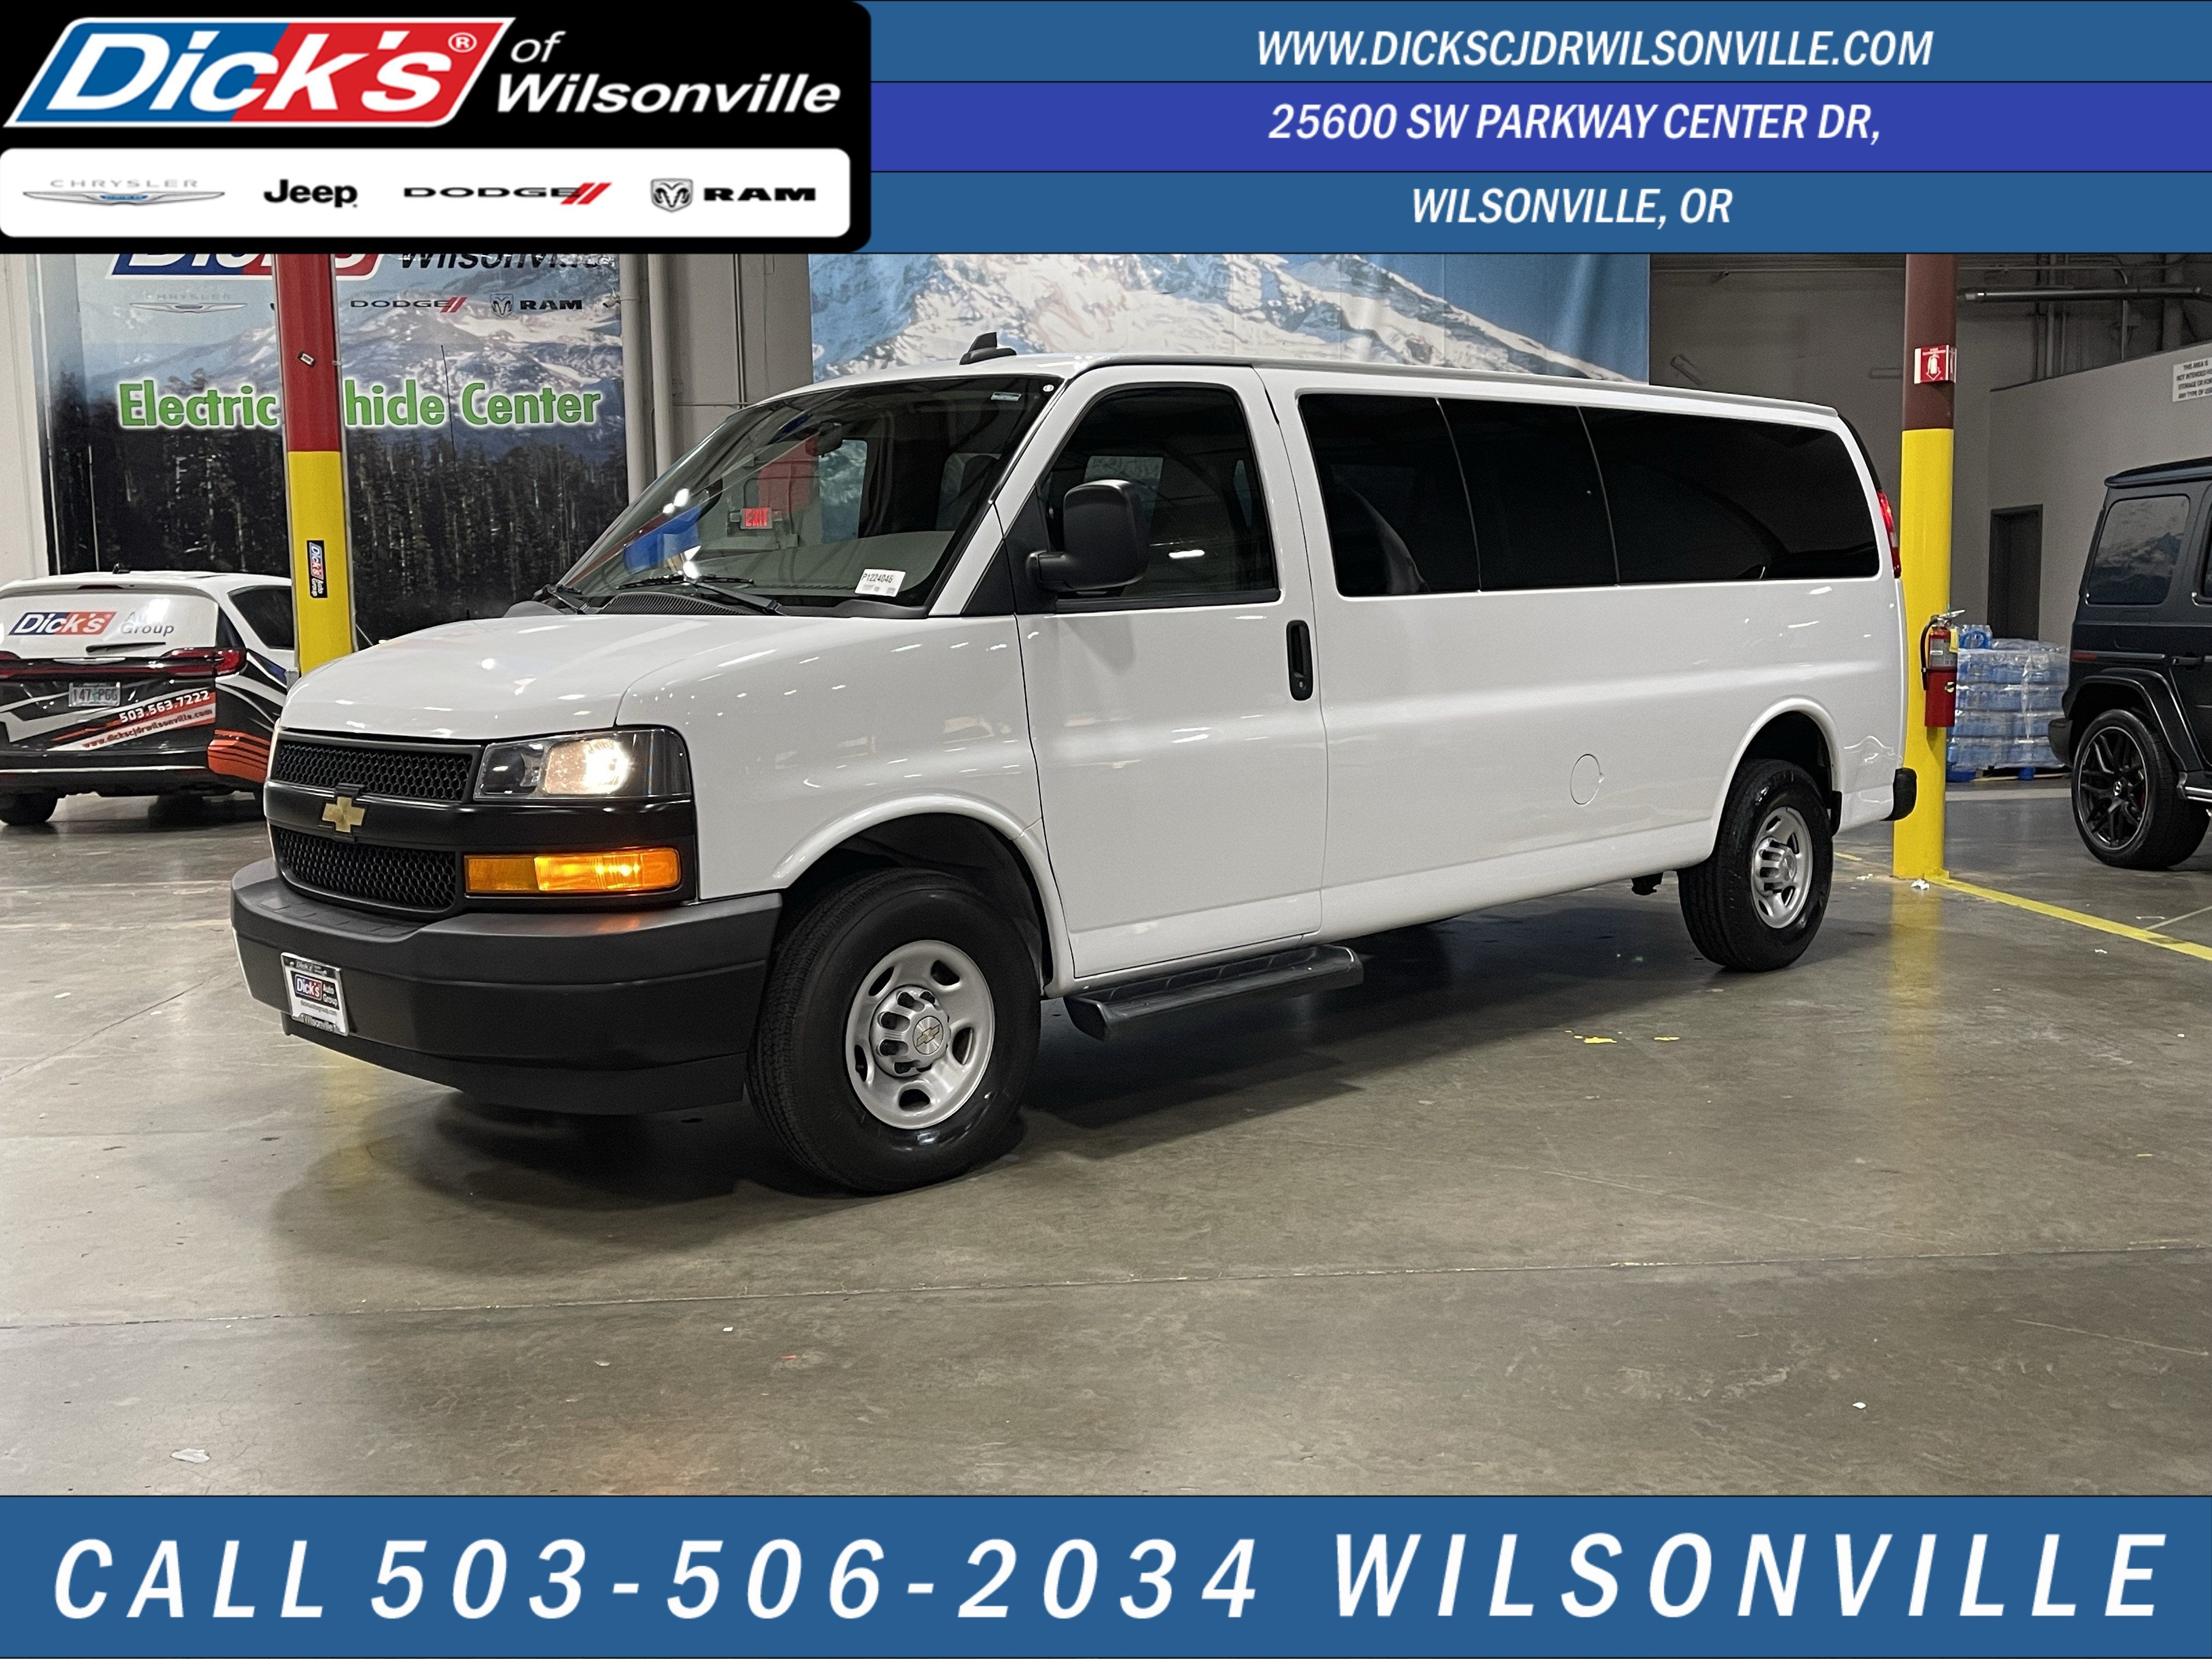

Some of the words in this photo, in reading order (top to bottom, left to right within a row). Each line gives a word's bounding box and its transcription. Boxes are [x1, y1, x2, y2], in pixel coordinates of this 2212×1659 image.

[520, 300, 583, 310] RAM
[119, 380, 277, 426] Electric
[344, 380, 444, 426] hicle
[462, 382, 601, 425] Center
[744, 509, 768, 526] EXIT
[14, 613, 105, 634] Dick's
[121, 622, 174, 636] Group
[119, 690, 211, 723] 503.563.7222
[296, 978, 320, 998] Dick's
